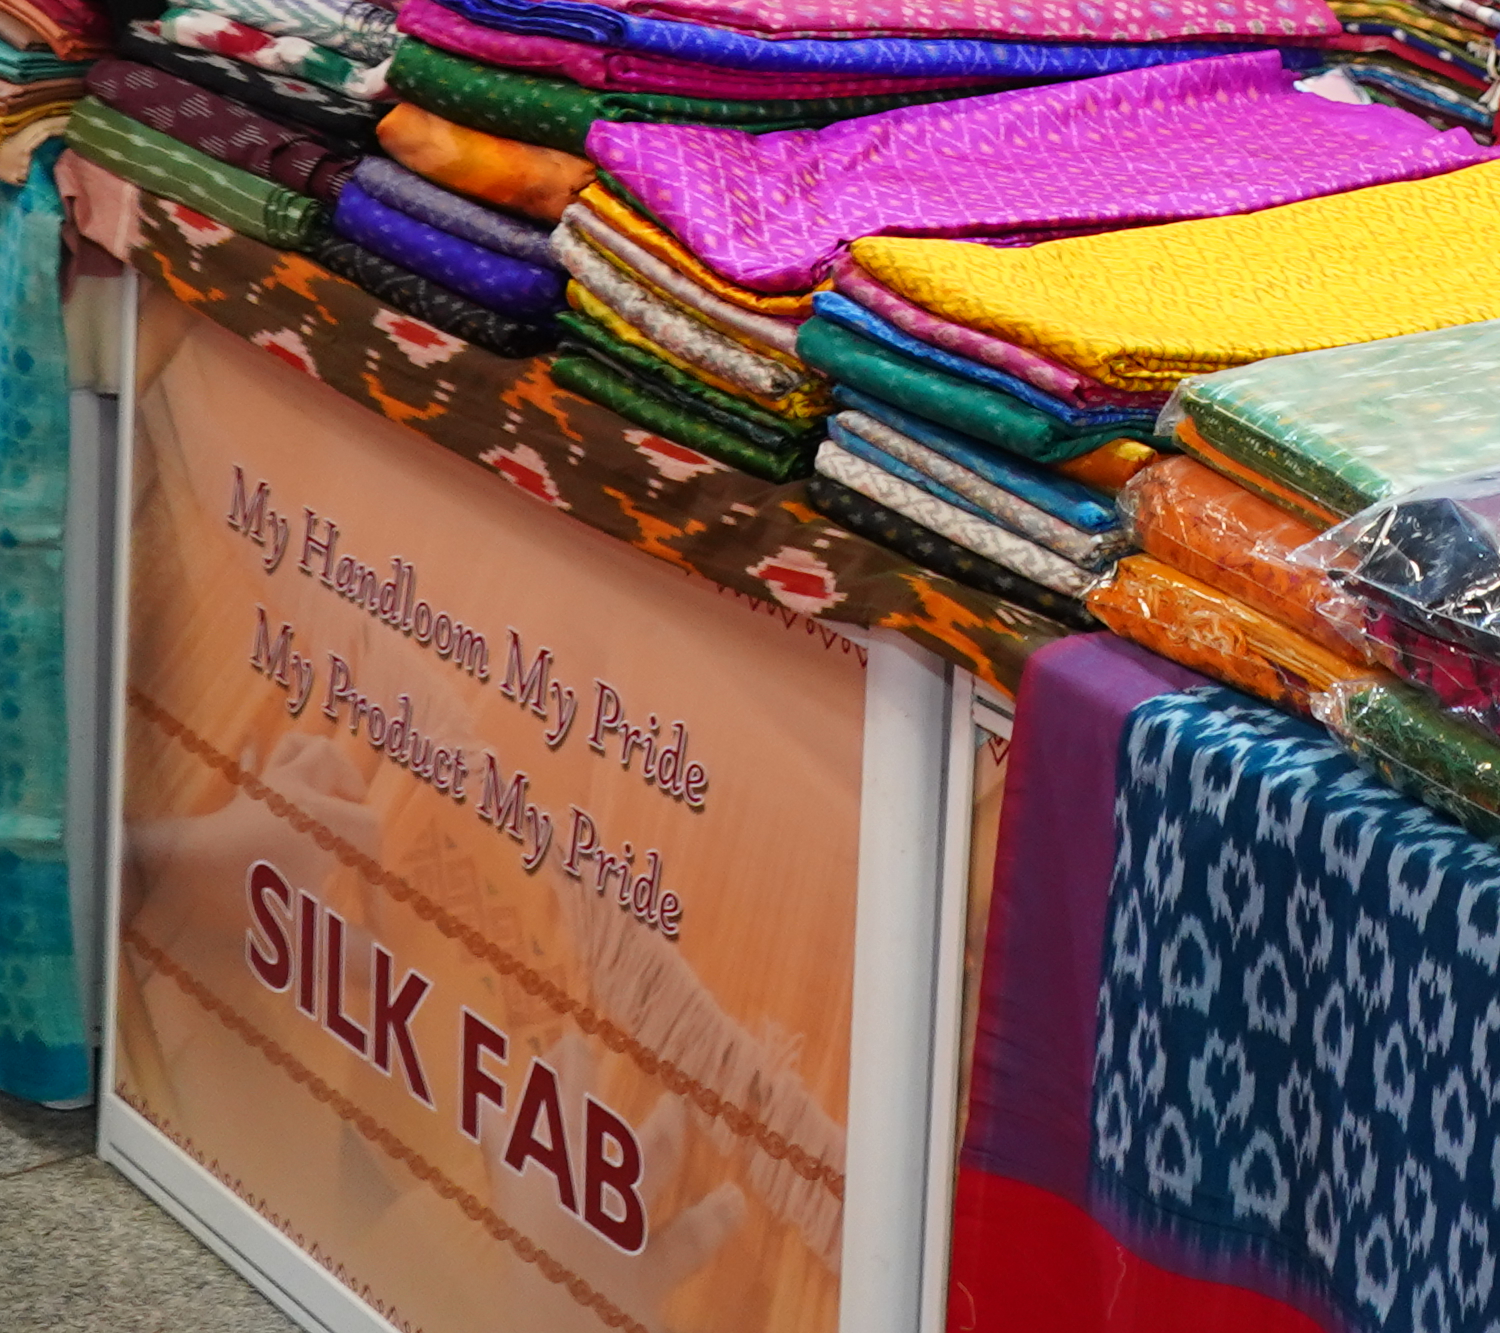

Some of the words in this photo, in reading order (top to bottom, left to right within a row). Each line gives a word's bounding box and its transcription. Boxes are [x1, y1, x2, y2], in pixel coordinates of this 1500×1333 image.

[226, 463, 289, 574] My
[297, 503, 491, 682] Handloom
[500, 623, 579, 751] My
[587, 676, 709, 810] Pride
[249, 602, 313, 716] My
[321, 648, 471, 801] Product
[476, 747, 554, 874] My
[562, 803, 684, 939] Pride
[243, 857, 438, 1111] SILK
[456, 1001, 650, 1259] FAB
